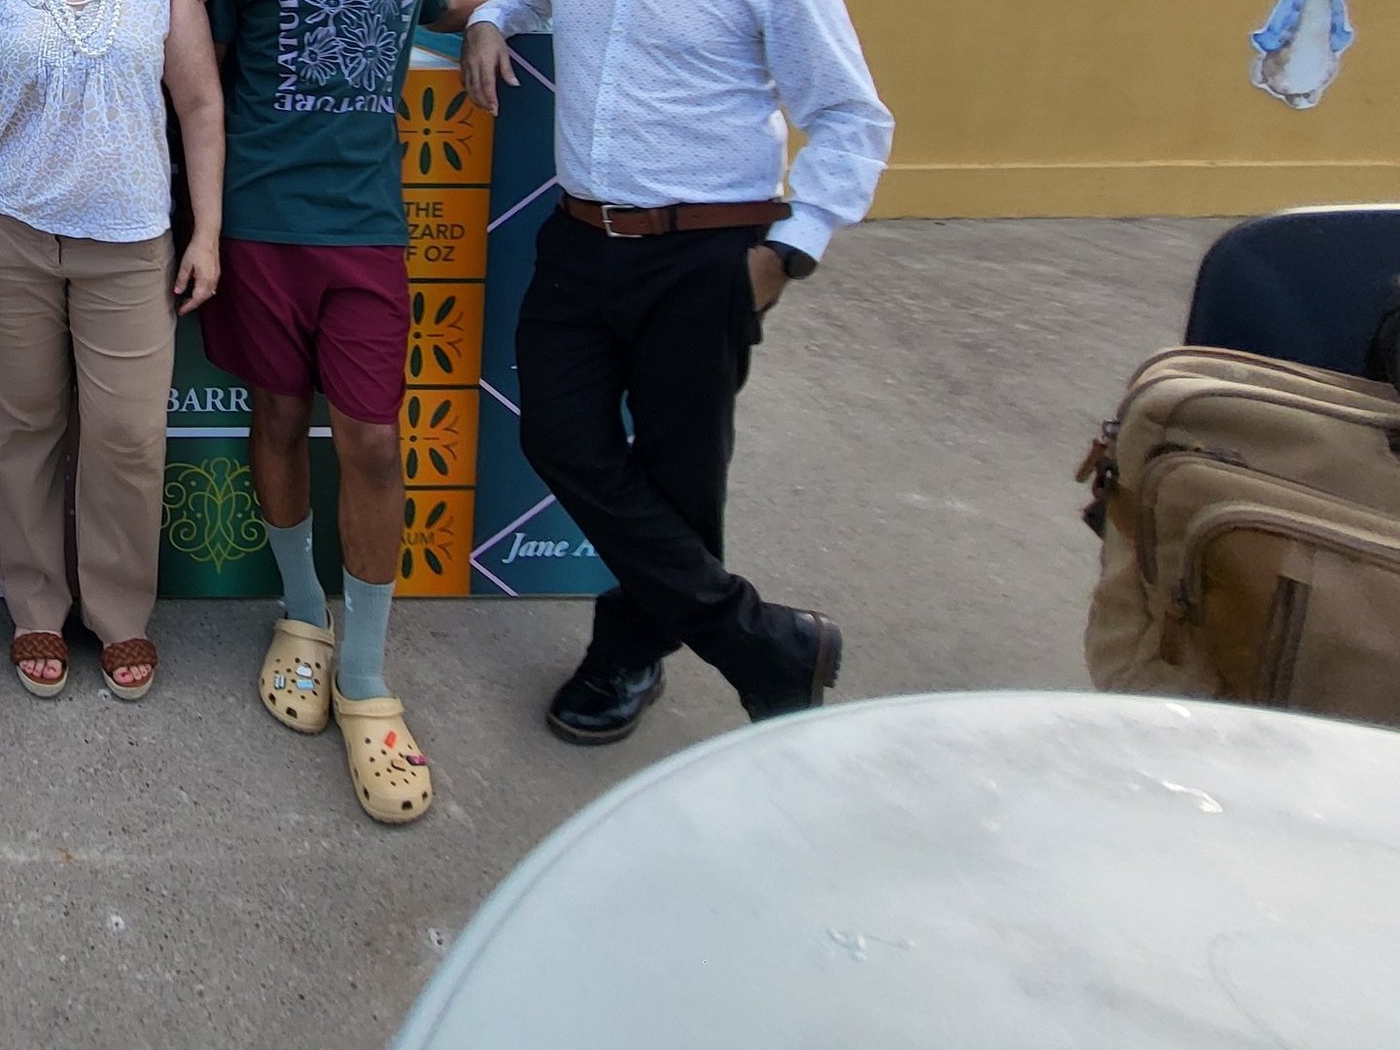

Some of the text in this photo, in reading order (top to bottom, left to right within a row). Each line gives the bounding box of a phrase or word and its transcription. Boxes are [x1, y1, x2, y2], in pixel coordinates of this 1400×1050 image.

[273, 92, 396, 114] NURTURE
[404, 201, 444, 218] THE
[408, 223, 466, 240] ZARD
[406, 245, 456, 262] F OZ
[166, 387, 253, 412] BARR
[501, 532, 570, 564] Jane
